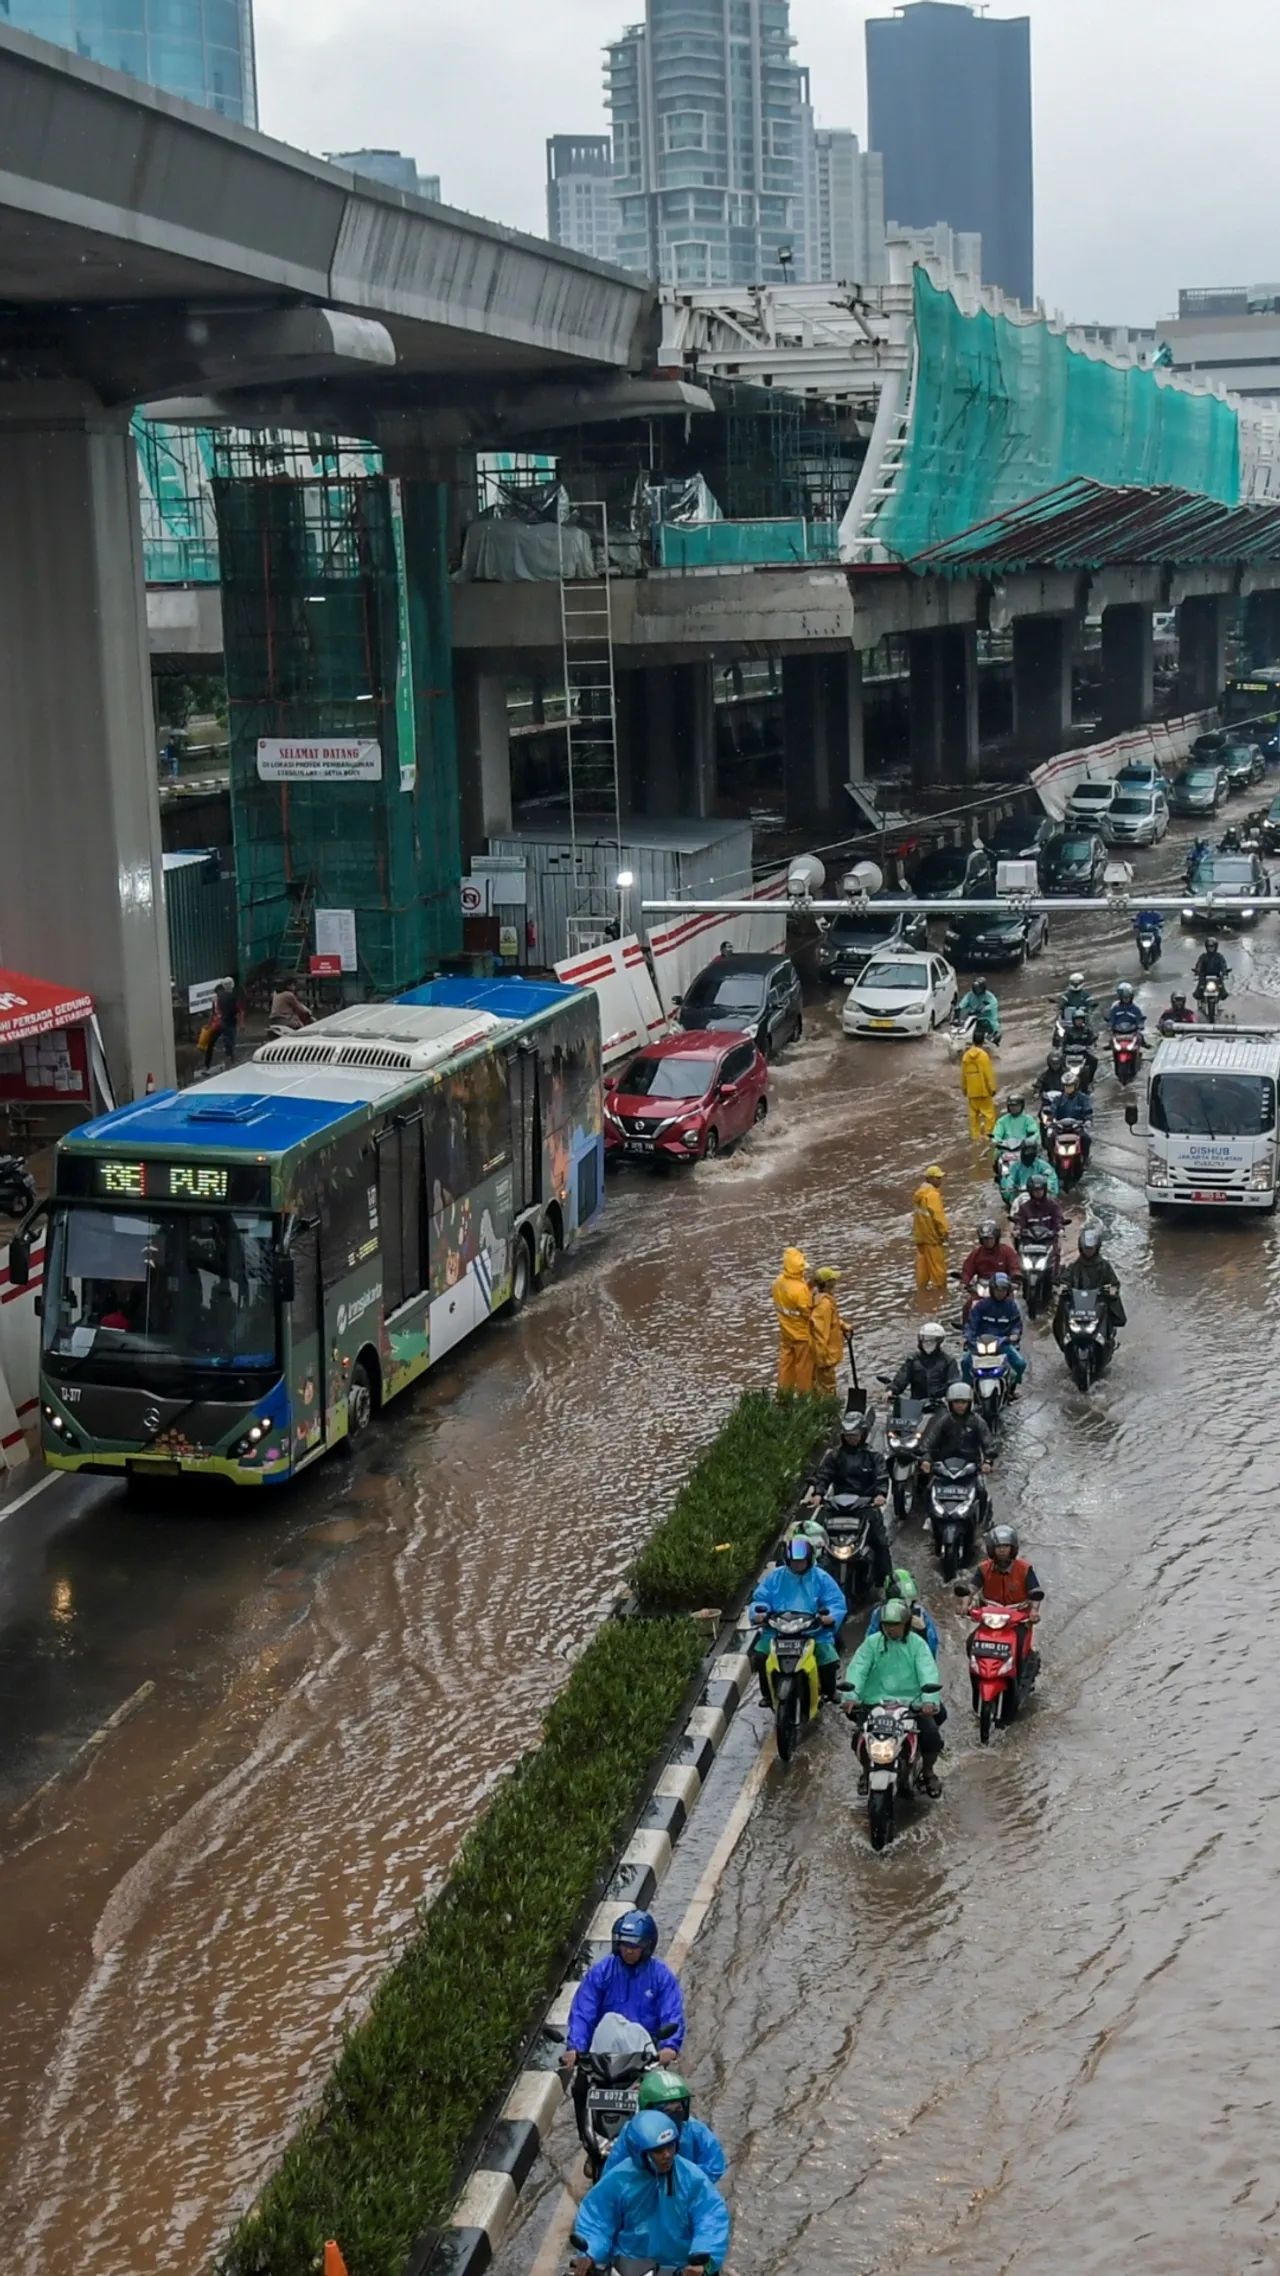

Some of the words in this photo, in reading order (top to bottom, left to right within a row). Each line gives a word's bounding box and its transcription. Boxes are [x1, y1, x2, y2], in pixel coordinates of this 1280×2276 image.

[280, 748, 319, 759] SELAMAT
[323, 748, 359, 759] DATANG
[13, 1008, 53, 1028] PERSADA
[55, 996, 91, 1015] GEDUNG
[7, 1023, 39, 1040] STASIUN
[40, 1019, 53, 1031] LRT
[1189, 1146, 1230, 1156] DISHUB
[169, 1168, 228, 1196] PURI
[589, 2091, 600, 2100] AD
